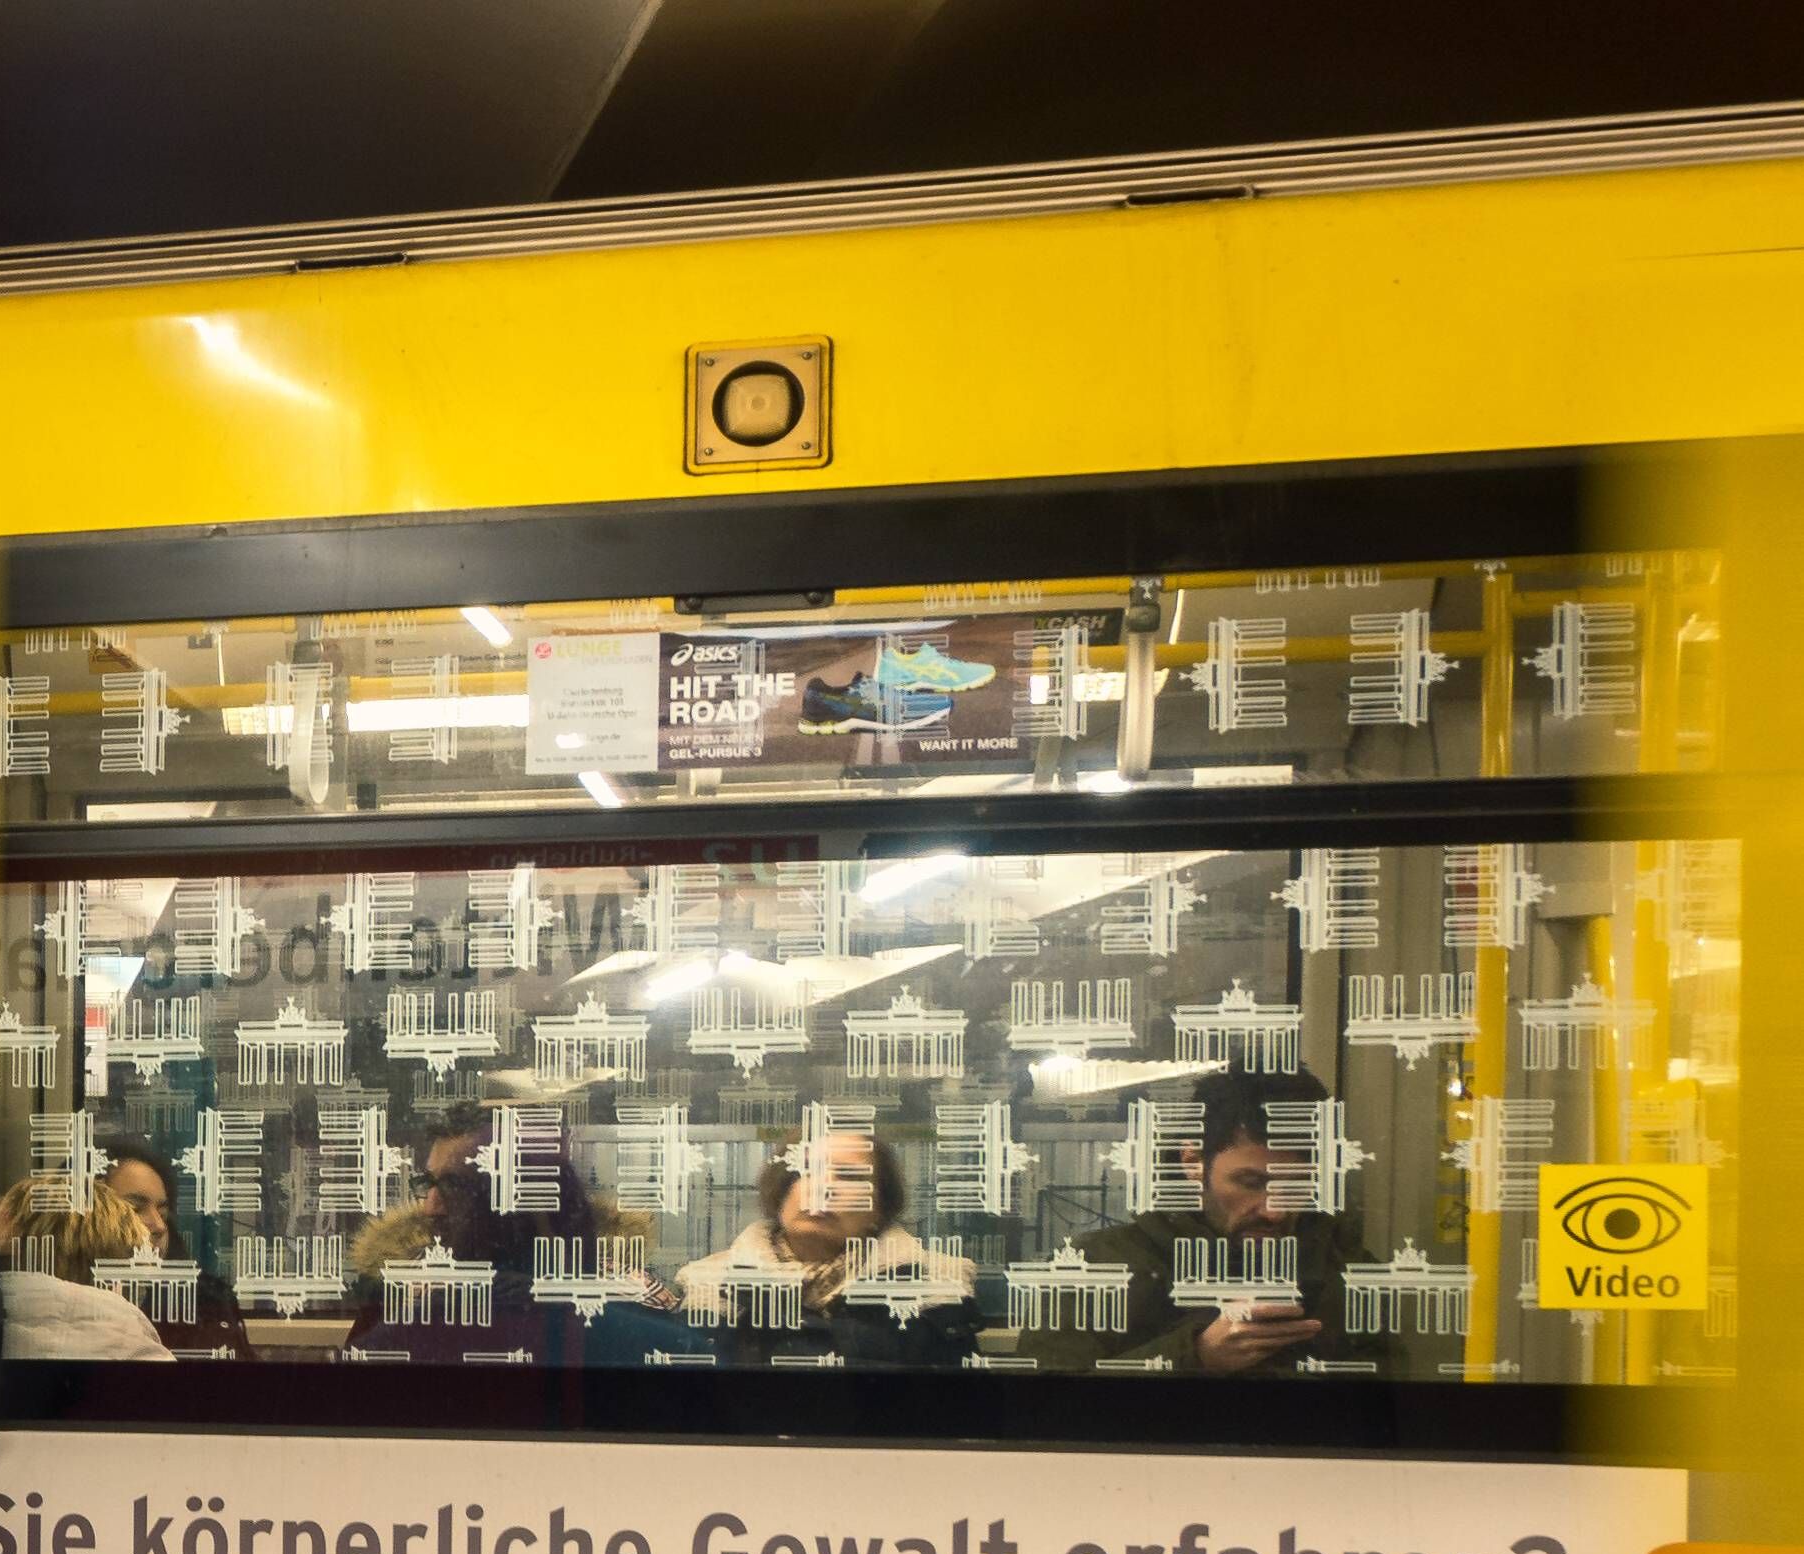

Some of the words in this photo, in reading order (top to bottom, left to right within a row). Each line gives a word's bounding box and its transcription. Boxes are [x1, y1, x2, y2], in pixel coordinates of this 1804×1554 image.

[669, 674, 723, 699] HIT
[731, 672, 796, 696] THE
[669, 700, 761, 724] ROAD
[919, 738, 958, 751] WANT
[961, 738, 974, 750] IT
[977, 737, 1018, 750] MORE
[1565, 1264, 1681, 1298] Video
